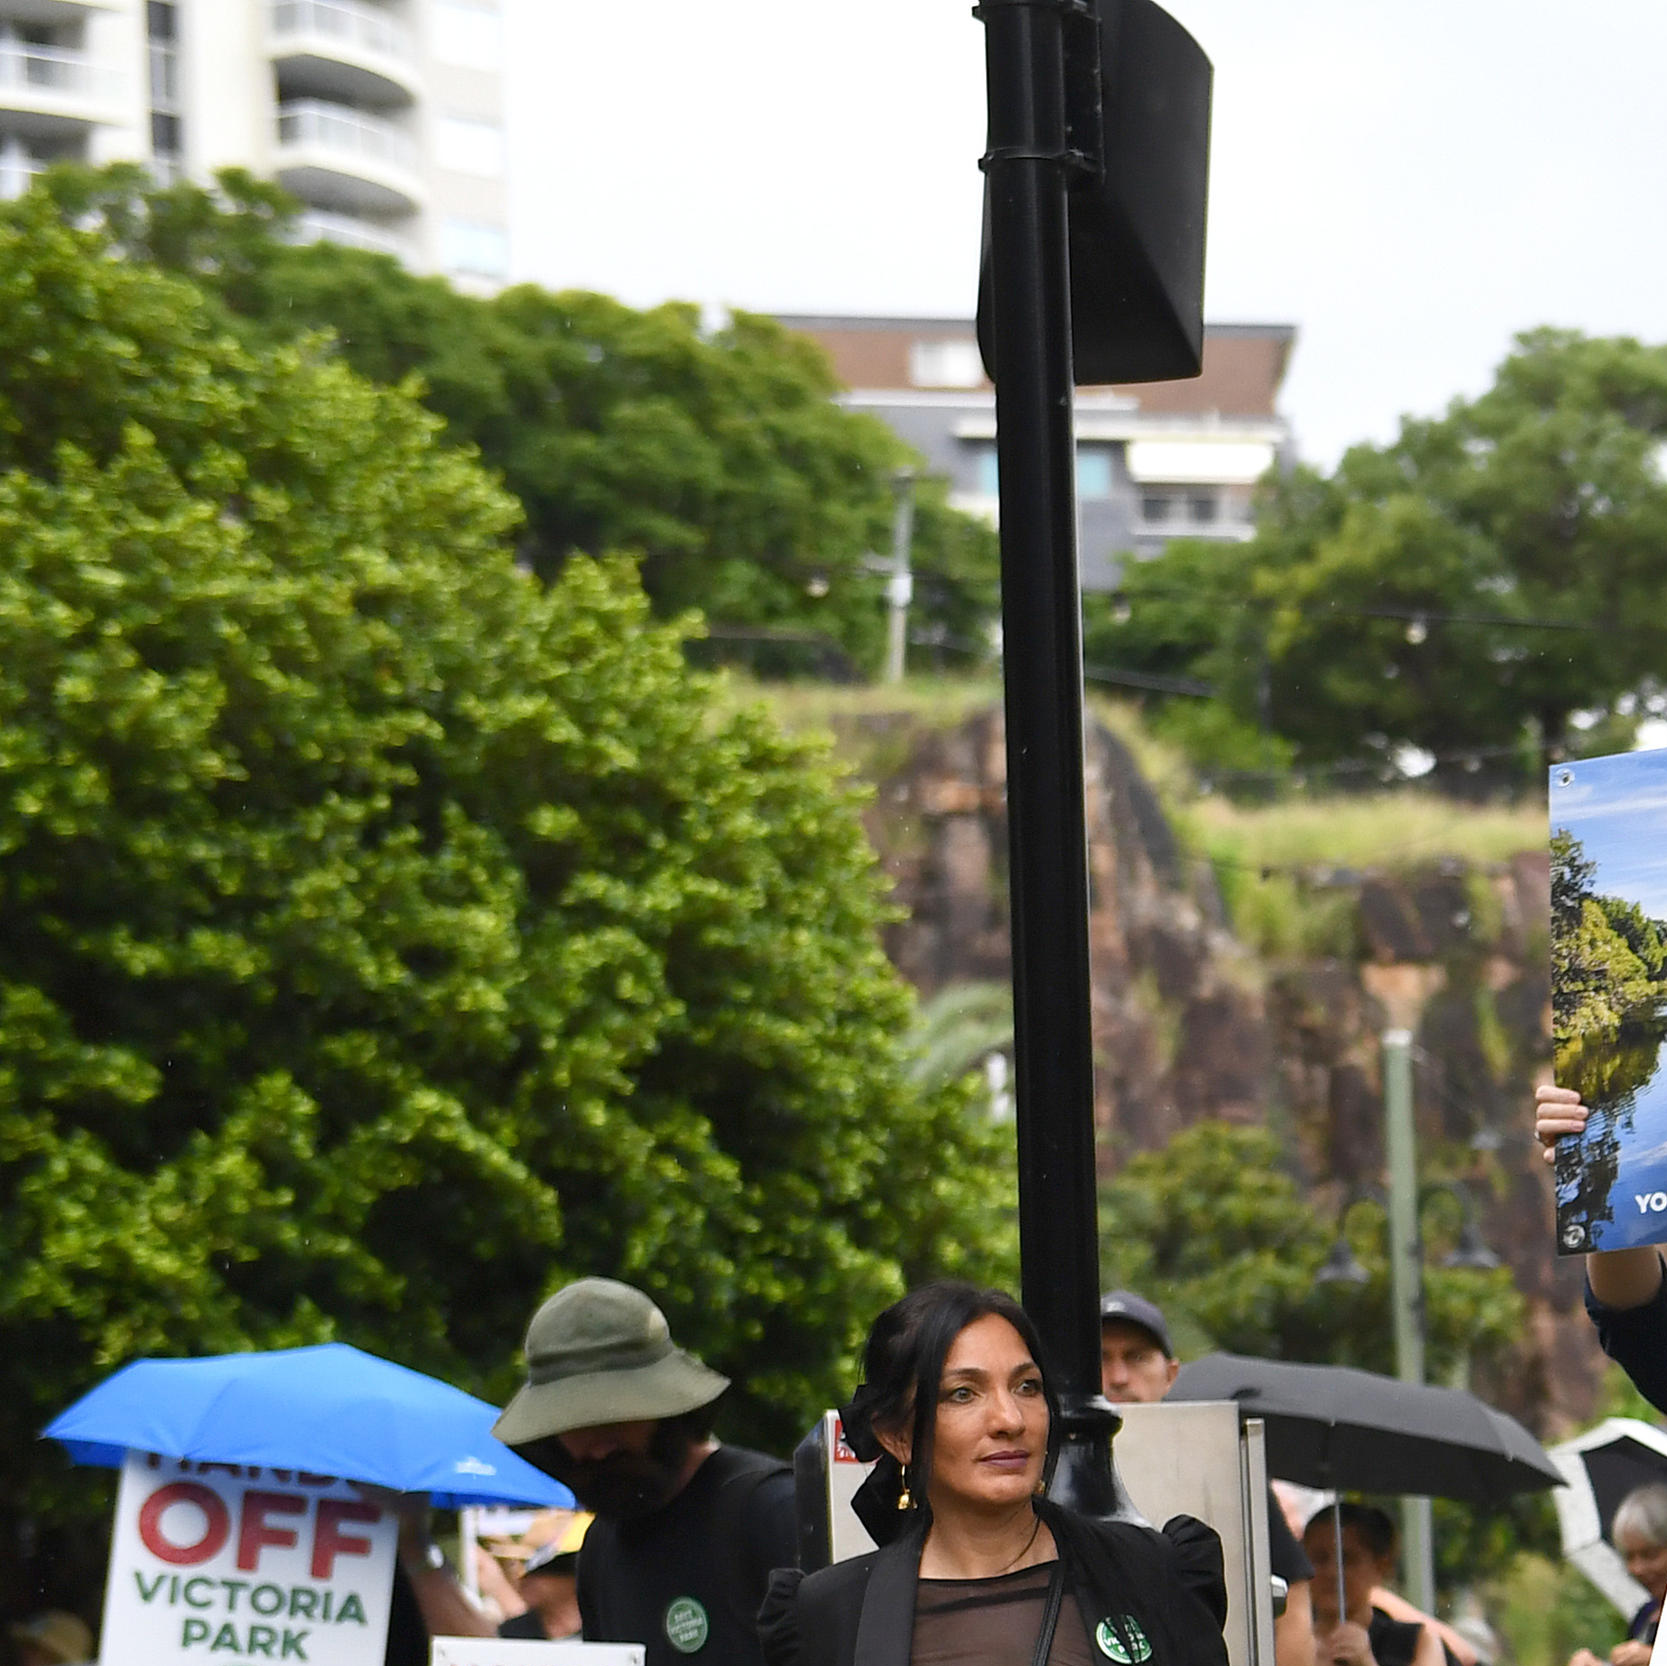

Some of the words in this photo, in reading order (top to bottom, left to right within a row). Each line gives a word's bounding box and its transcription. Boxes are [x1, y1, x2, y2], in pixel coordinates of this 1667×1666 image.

[139, 1482, 382, 1579] OFF
[134, 1571, 367, 1626] VICTORIA
[181, 1619, 313, 1662] PARK
